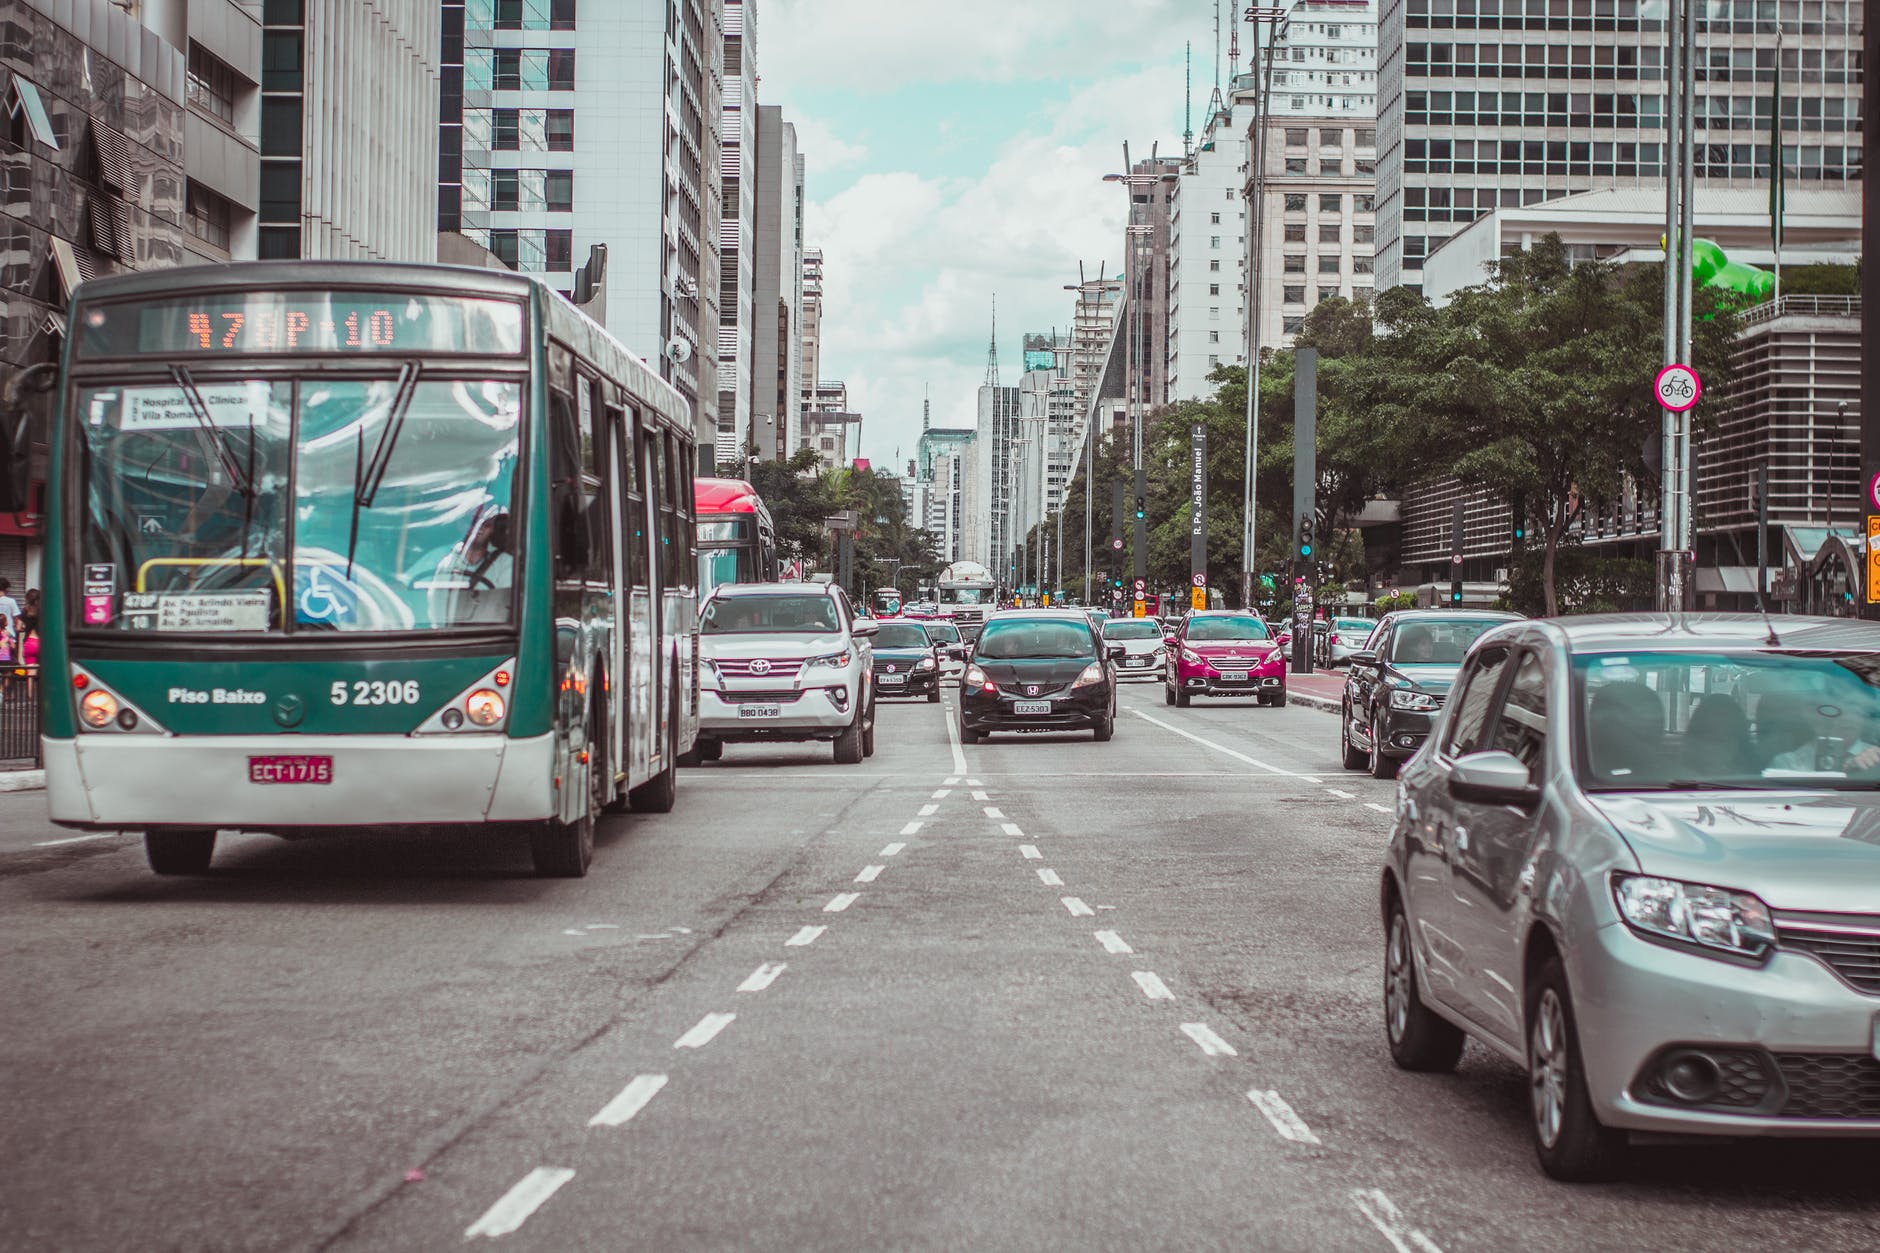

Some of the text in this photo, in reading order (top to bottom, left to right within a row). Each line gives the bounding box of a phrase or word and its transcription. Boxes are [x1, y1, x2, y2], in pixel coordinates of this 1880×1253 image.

[142, 410, 161, 420] Vila
[1193, 448, 1202, 482] Manuel
[1193, 484, 1202, 507] João
[168, 688, 267, 704] Piso Baixo
[330, 680, 420, 705] 5 2306
